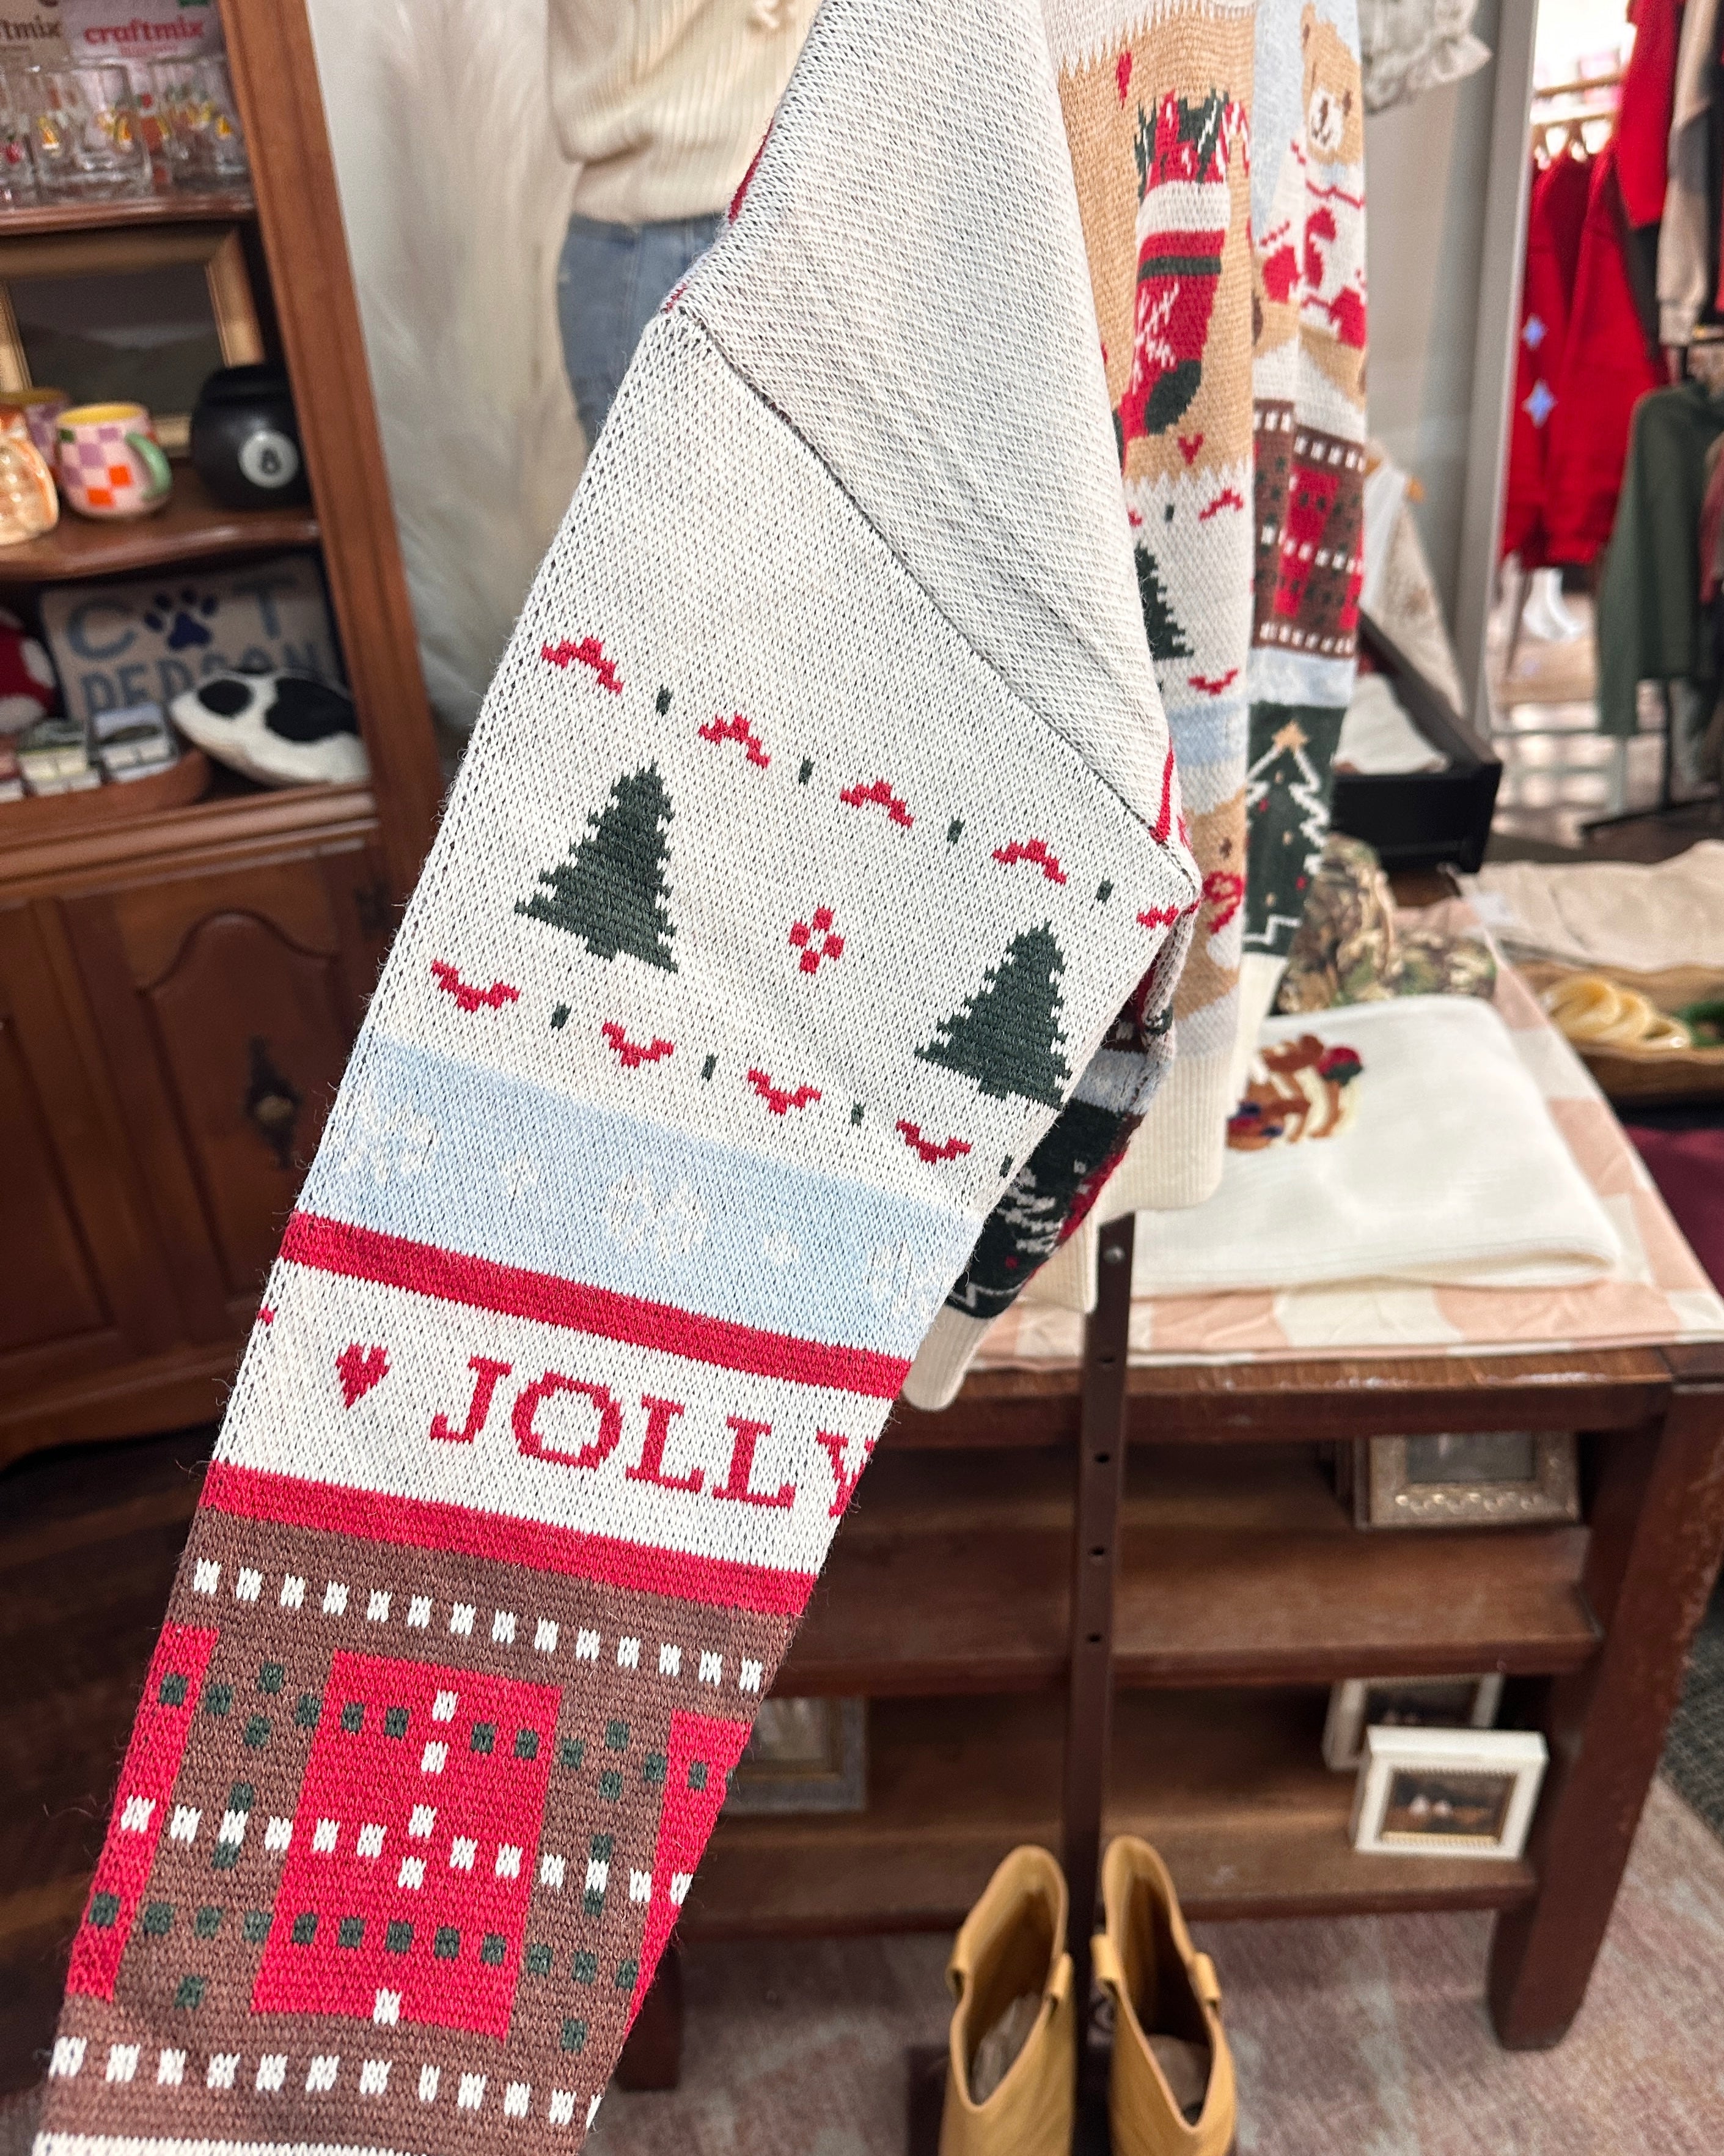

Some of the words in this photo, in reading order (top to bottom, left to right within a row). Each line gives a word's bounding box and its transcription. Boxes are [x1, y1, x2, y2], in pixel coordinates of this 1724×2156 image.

[83, 15, 204, 45] craftmix
[260, 447, 281, 475] 8
[430, 1355, 875, 1518] JOLLY
